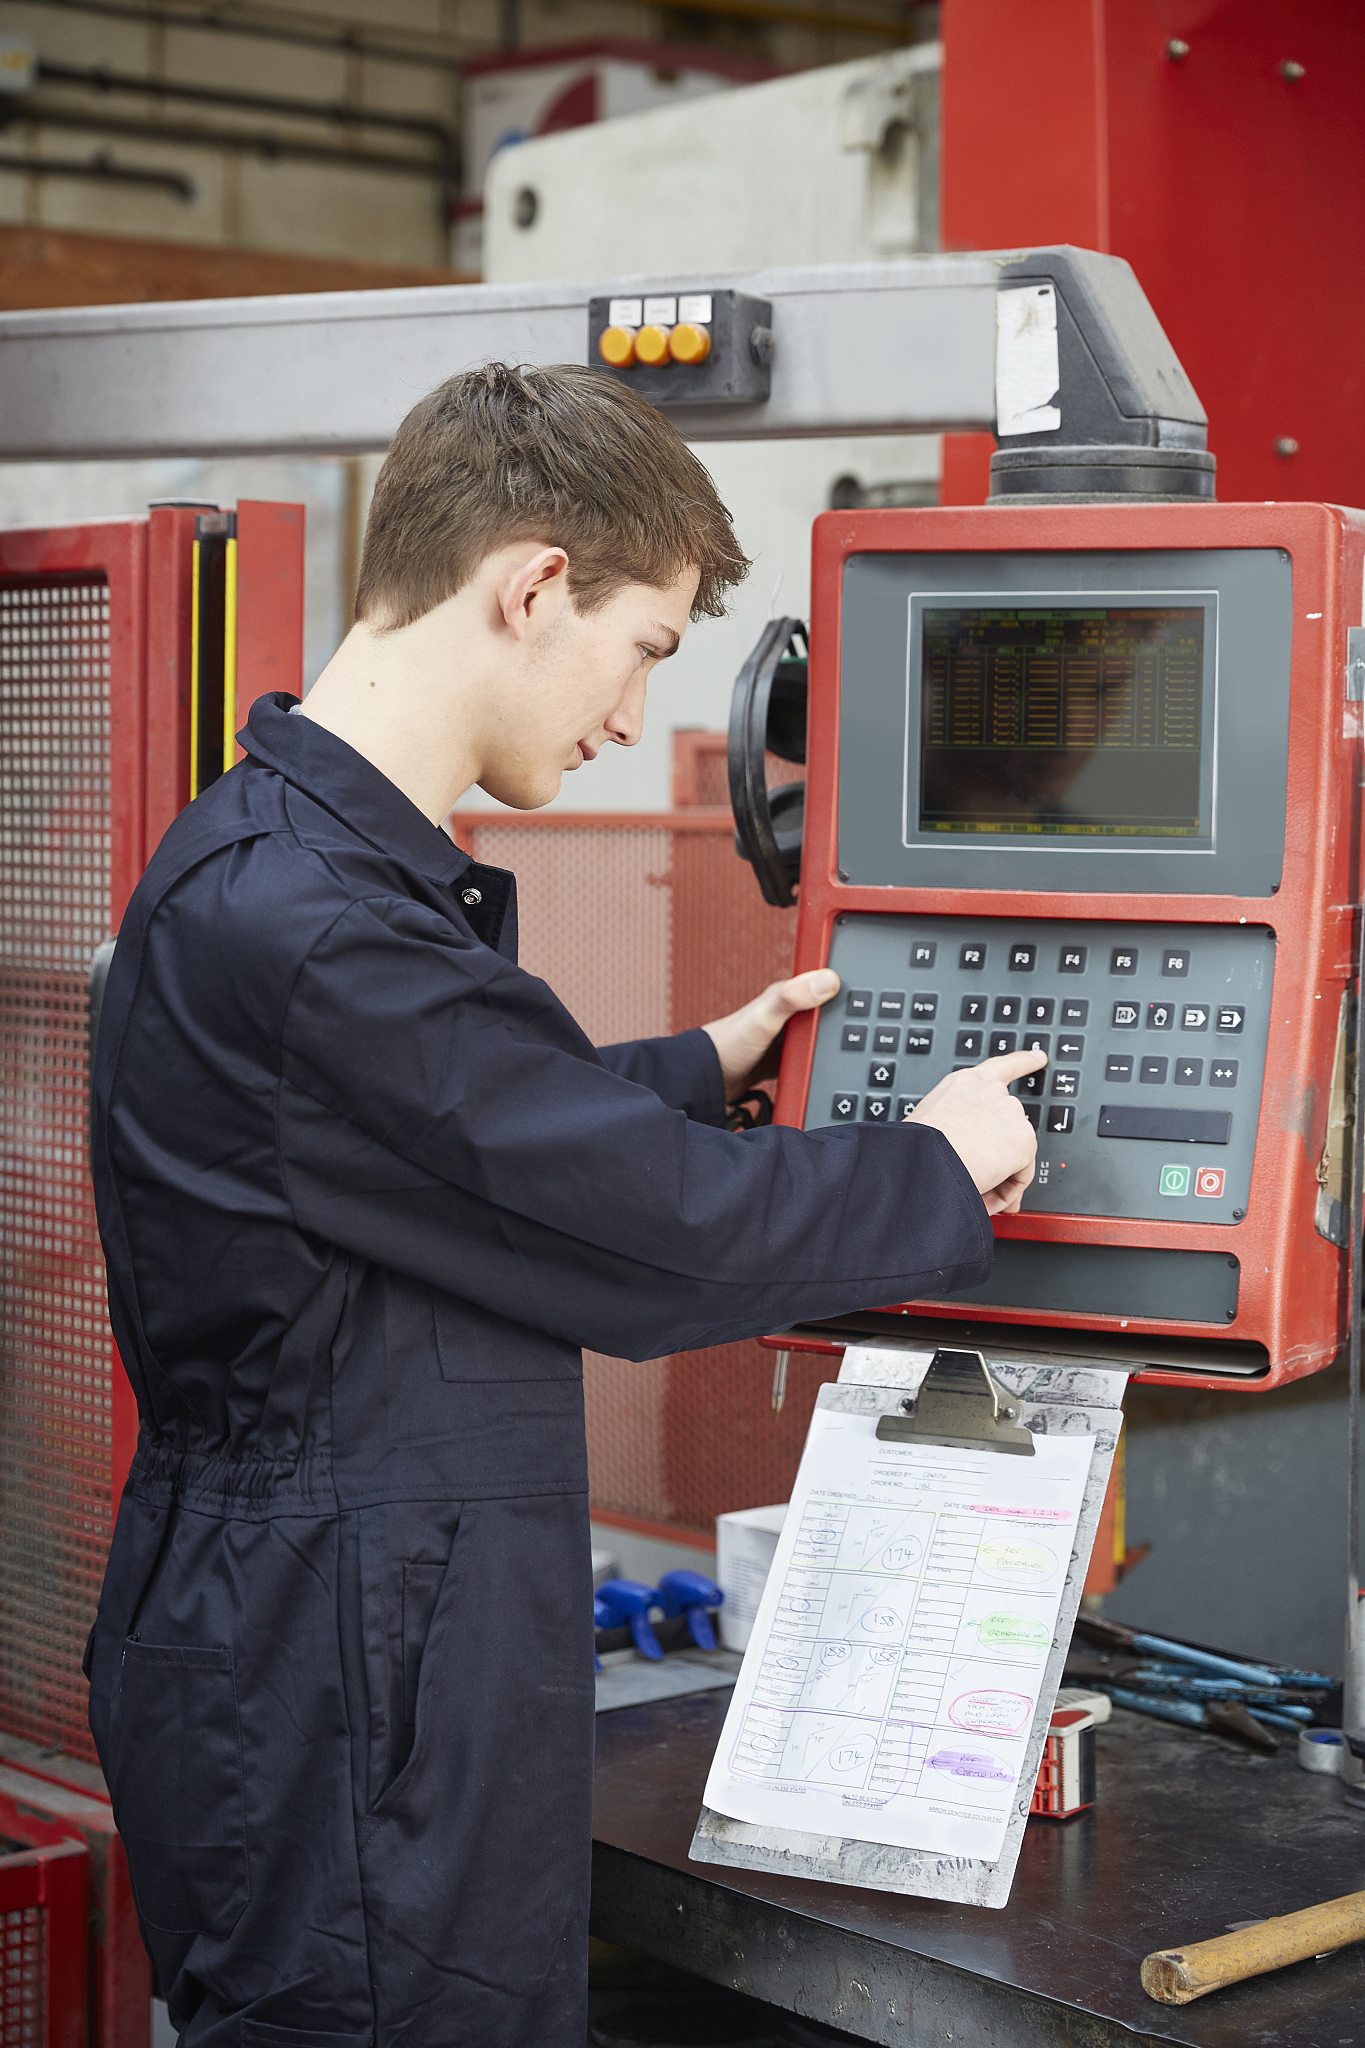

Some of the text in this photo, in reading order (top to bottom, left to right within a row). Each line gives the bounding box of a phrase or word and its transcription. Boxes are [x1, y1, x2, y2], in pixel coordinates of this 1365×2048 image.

[917, 949, 930, 960] F1
[965, 950, 979, 962] F2
[1015, 952, 1029, 963] F3
[1065, 955, 1080, 965] F4
[1116, 956, 1131, 967] F5
[1168, 958, 1183, 969] F6
[914, 1002, 923, 1011] Pg
[970, 1003, 978, 1014] 7
[1003, 1005, 1011, 1016] 8
[1037, 1006, 1045, 1017] 9
[909, 1037, 919, 1046] Pg
[965, 1038, 973, 1048] 4
[998, 1040, 1006, 1050] 5
[1032, 1042, 1040, 1050] 6
[1027, 1078, 1035, 1087] 3
[873, 1470, 903, 1478] ORDERED
[888, 1548, 914, 1562] 174
[874, 1614, 894, 1626] 158
[839, 1751, 864, 1764] 174
[948, 1810, 971, 1818] DENOTES
[972, 1813, 992, 1822] COLOUR
